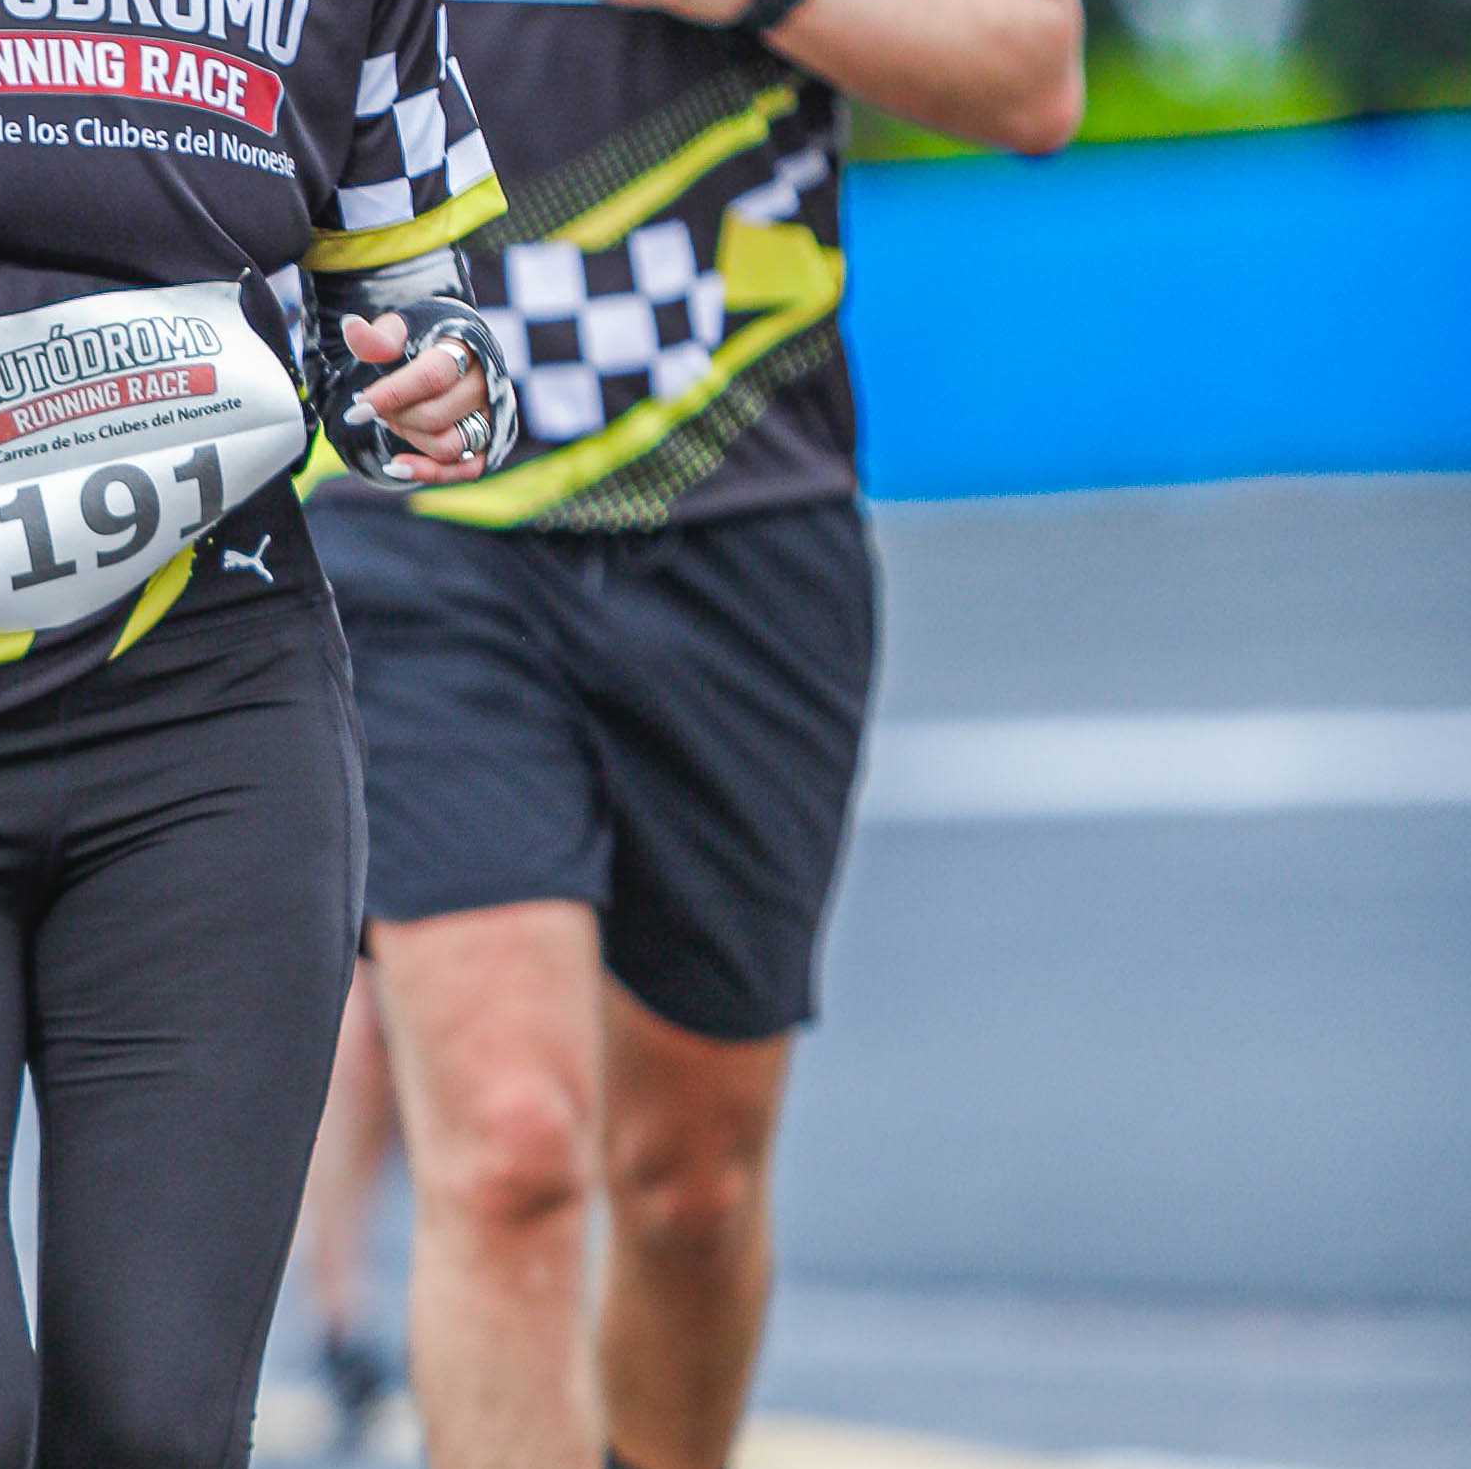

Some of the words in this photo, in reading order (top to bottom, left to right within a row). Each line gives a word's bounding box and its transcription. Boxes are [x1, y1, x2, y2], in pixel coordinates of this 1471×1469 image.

[139, 44, 249, 119] RACE
[27, 114, 70, 146] los
[74, 115, 170, 152] Clubes
[175, 125, 217, 158] del
[221, 131, 297, 180] Noroeste
[11, 381, 121, 435] RUNNING
[126, 370, 192, 405] RACE
[51, 435, 71, 451] de
[74, 427, 96, 446] los
[98, 418, 149, 439] Clubes
[151, 409, 175, 428] del
[178, 395, 243, 421] Noroeste
